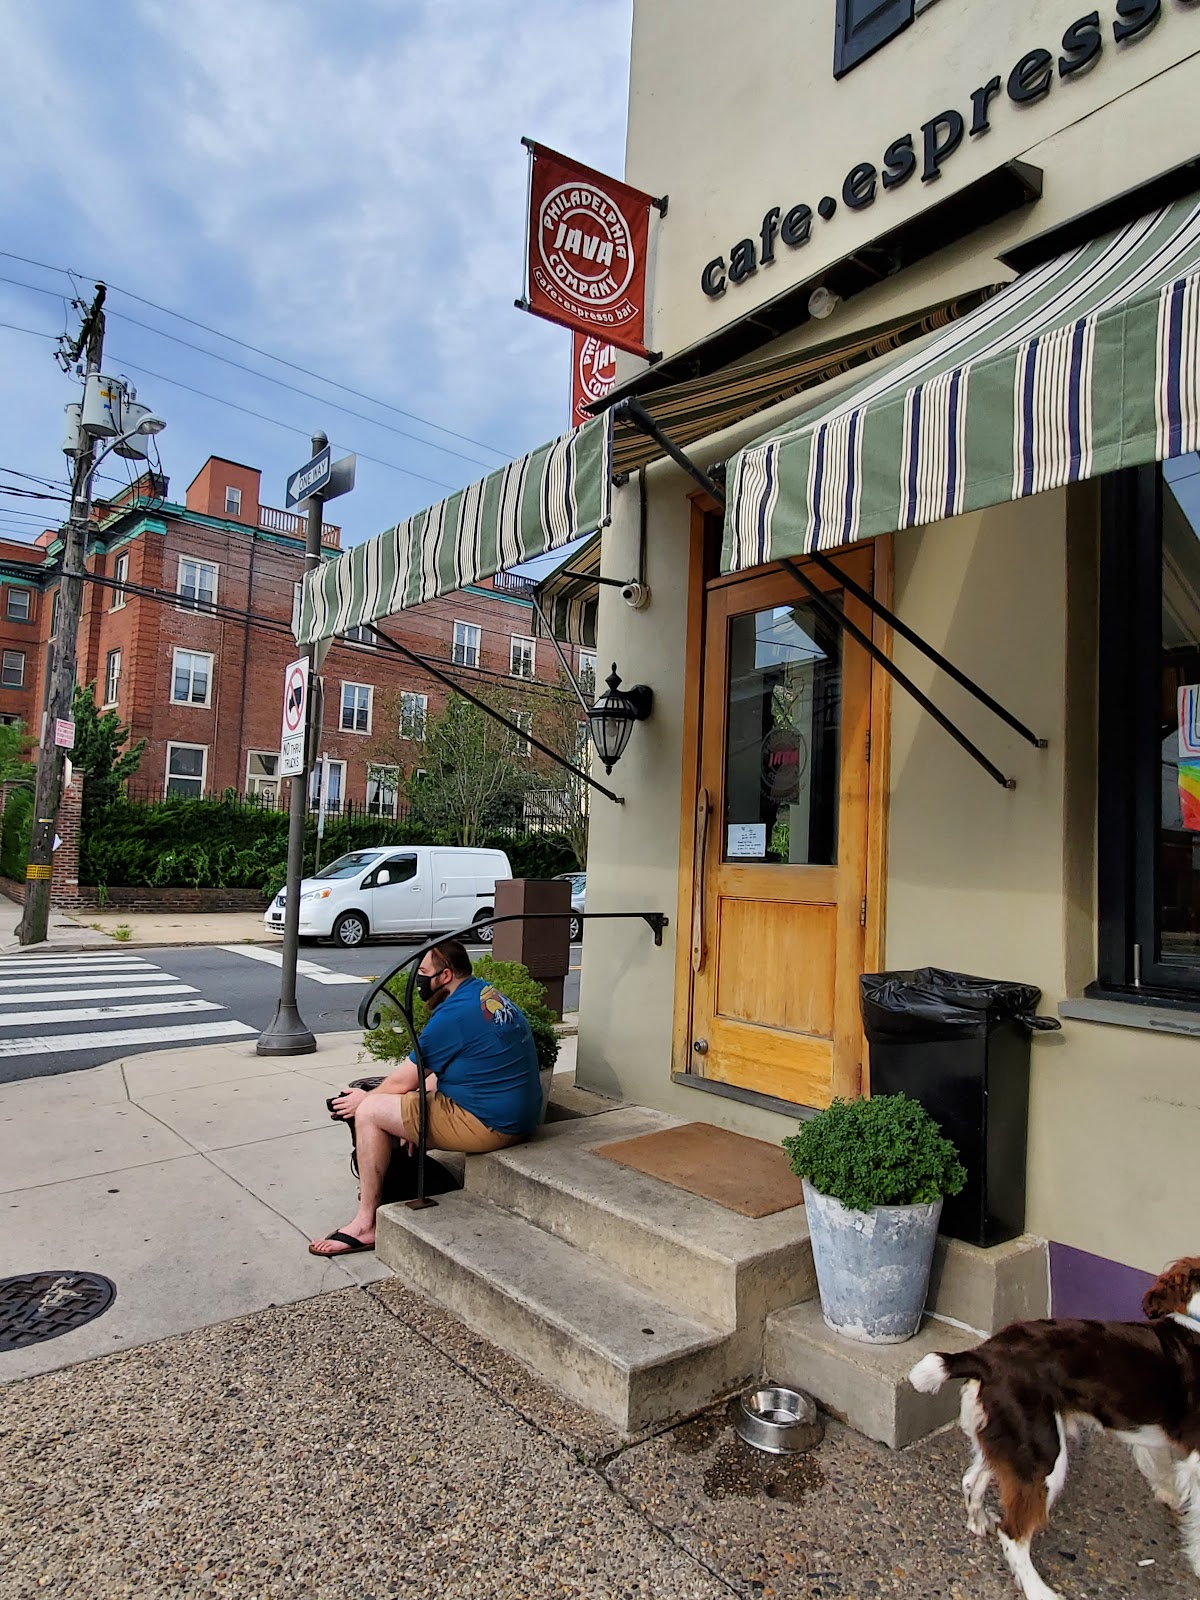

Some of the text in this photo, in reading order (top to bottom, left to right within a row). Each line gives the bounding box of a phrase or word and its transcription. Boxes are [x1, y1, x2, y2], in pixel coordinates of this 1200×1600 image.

[842, 0, 1200, 209] espress
[543, 190, 627, 260] PHILADELPHIA
[553, 221, 614, 267] JAVA
[549, 254, 618, 298] COMPANY
[614, 304, 632, 320] bar
[591, 344, 616, 374] JAV
[299, 459, 327, 490] ONE WAY
[283, 742, 302, 756] NO THRU
[285, 756, 300, 769] TRUCKS
